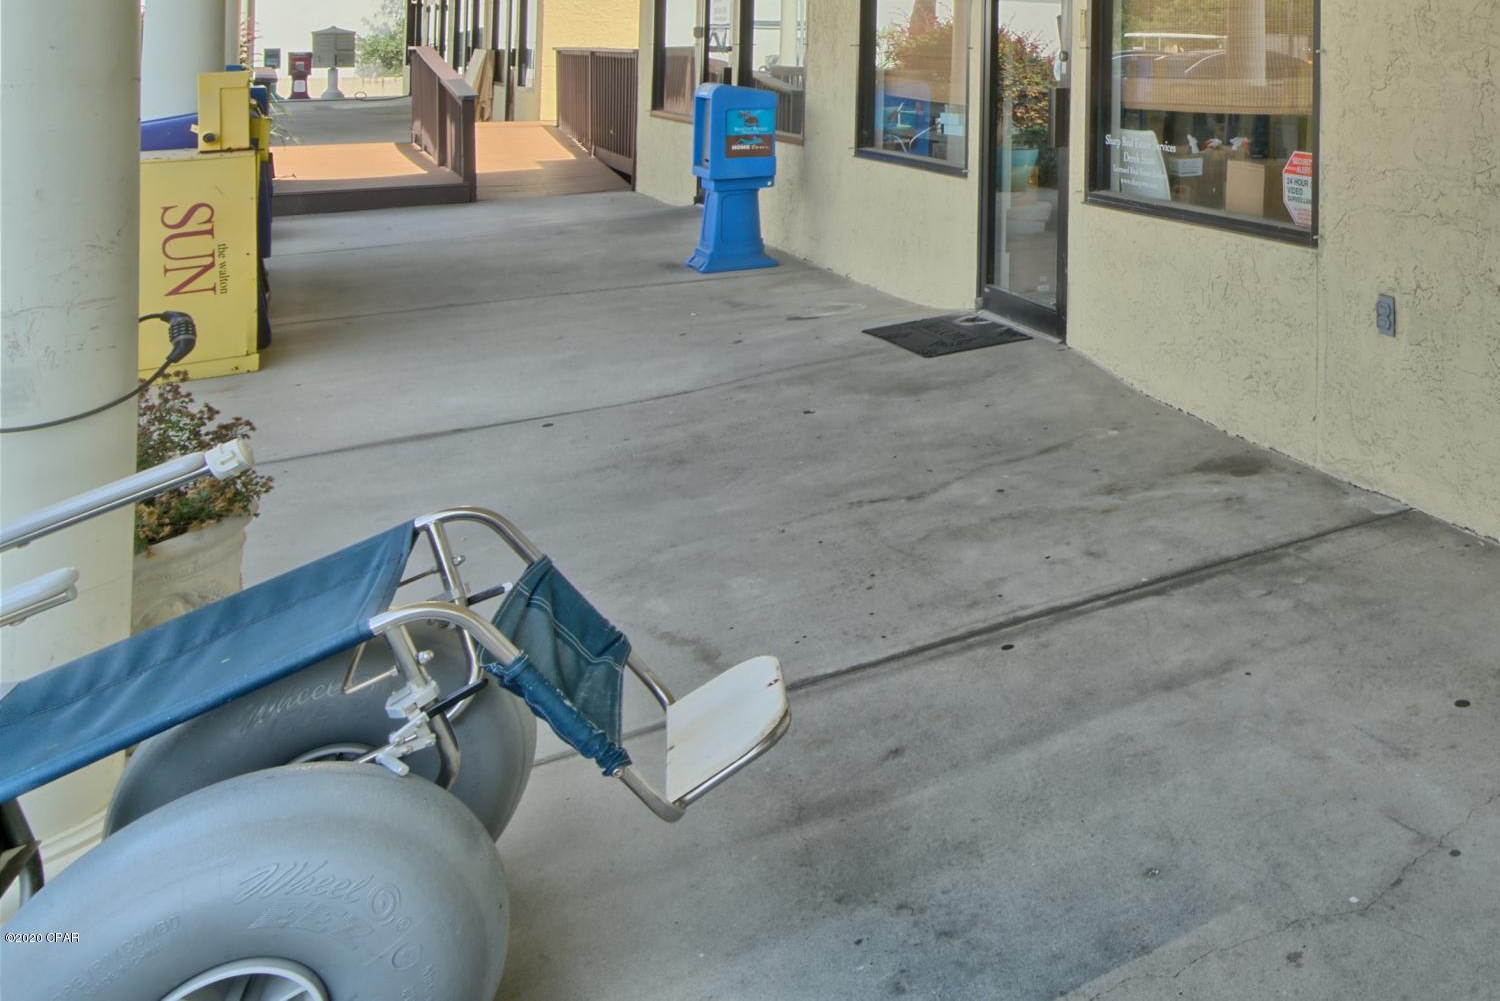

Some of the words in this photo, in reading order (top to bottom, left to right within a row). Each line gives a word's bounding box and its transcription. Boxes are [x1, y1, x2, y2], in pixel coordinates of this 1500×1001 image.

[1287, 186, 1304, 196] VIDEO
[160, 202, 217, 297] SUN
[217, 243, 228, 259] the
[218, 261, 230, 294] walton
[233, 859, 375, 905] Wheel
